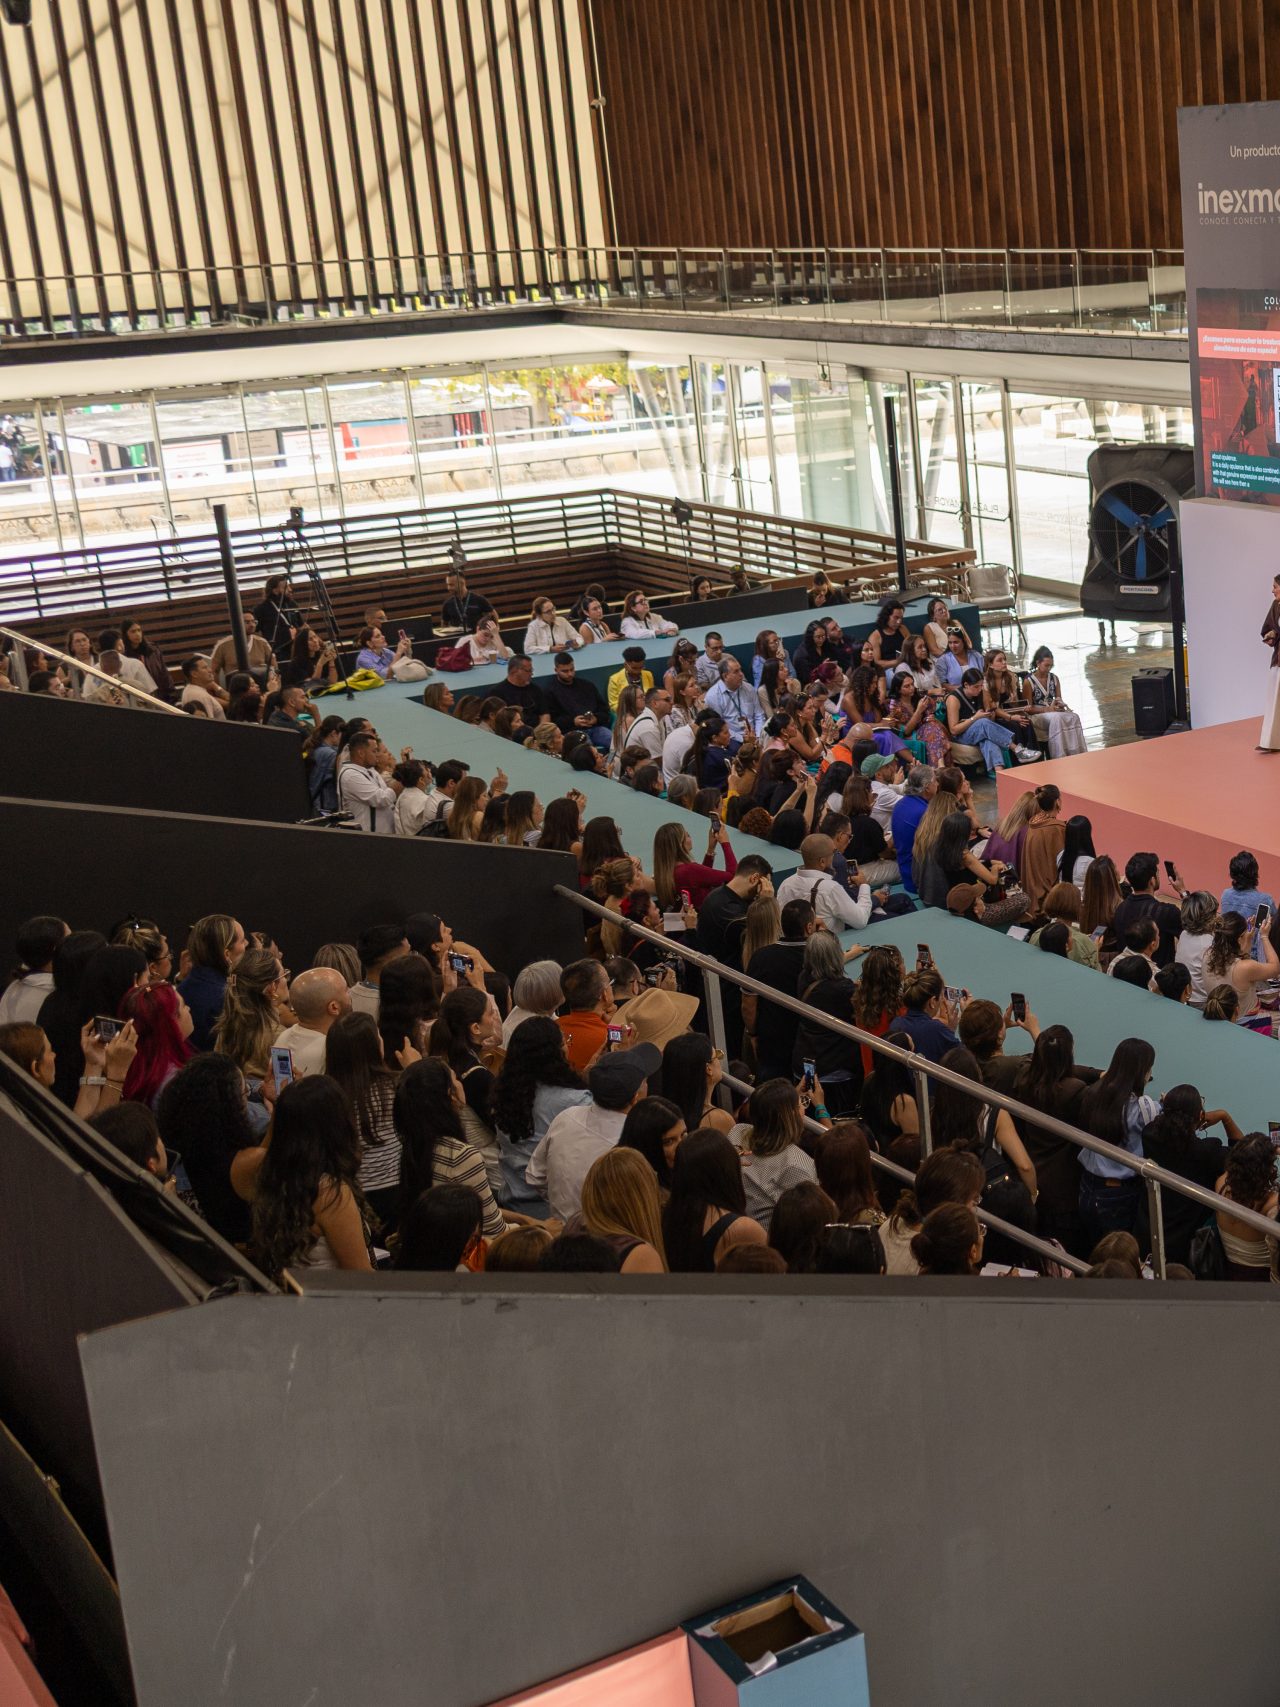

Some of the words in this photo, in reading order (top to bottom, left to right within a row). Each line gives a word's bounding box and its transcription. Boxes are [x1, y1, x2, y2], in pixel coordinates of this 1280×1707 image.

[1230, 145, 1242, 158] Un
[1200, 217, 1229, 226] CONOCE
[1234, 216, 1266, 225] CONECTA
